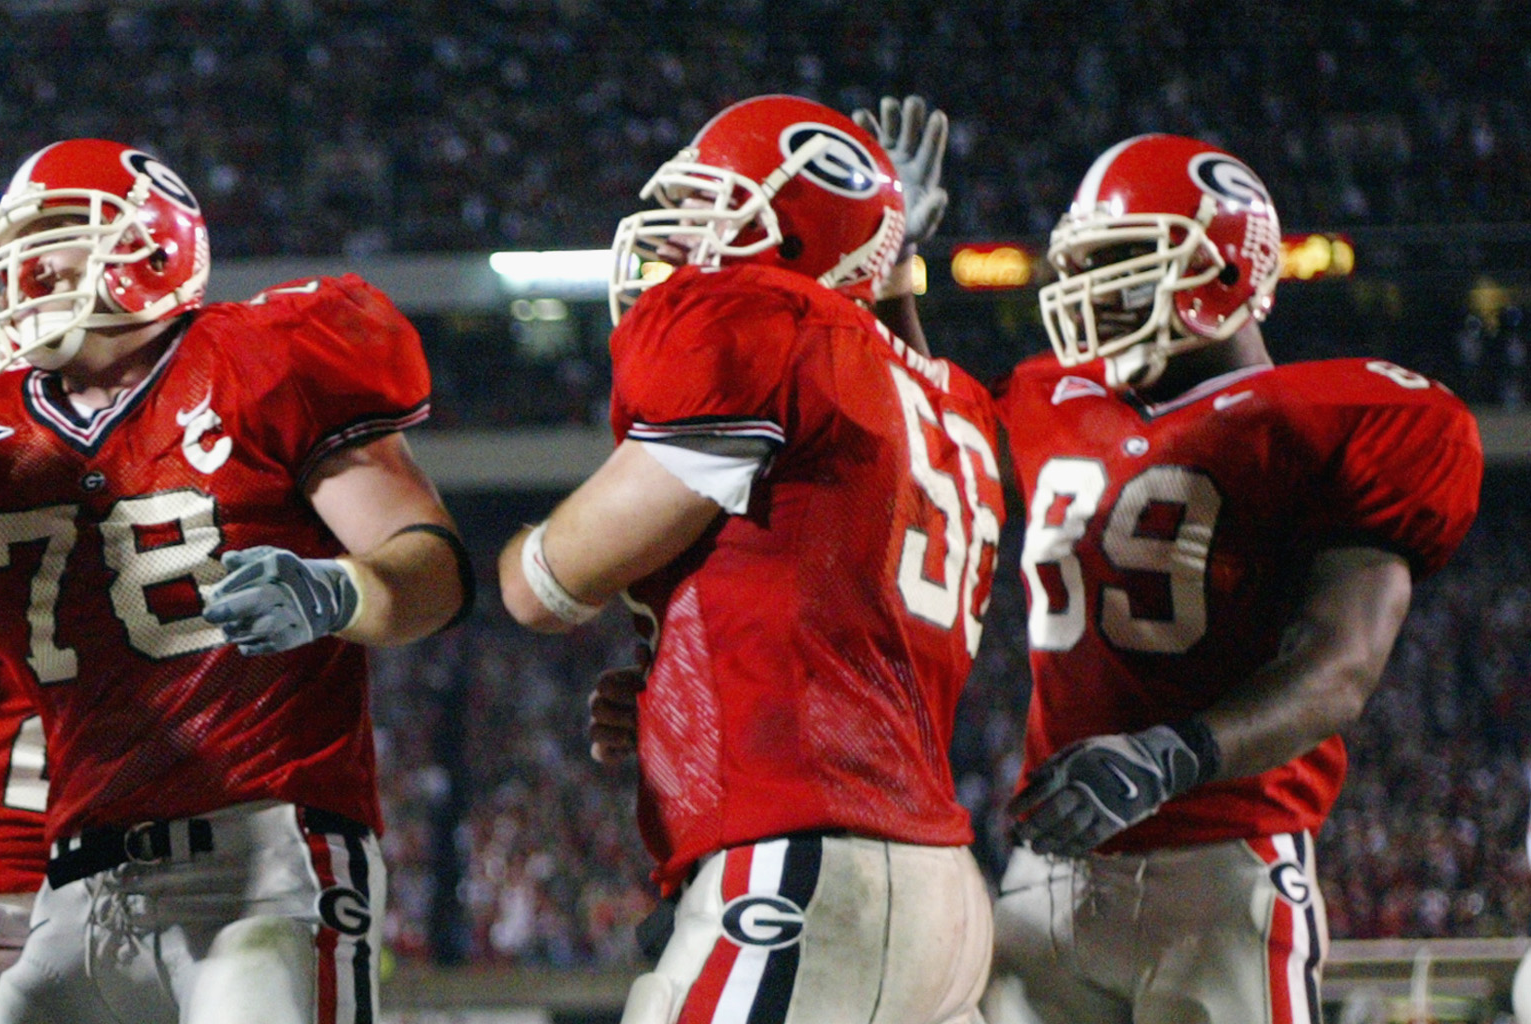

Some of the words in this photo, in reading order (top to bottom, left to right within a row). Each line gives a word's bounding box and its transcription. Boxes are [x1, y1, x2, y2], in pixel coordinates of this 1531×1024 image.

[182, 408, 233, 475] C
[1021, 457, 1222, 654] 89
[1269, 862, 1310, 904] G
[318, 887, 372, 936] G
[721, 896, 805, 947] G
